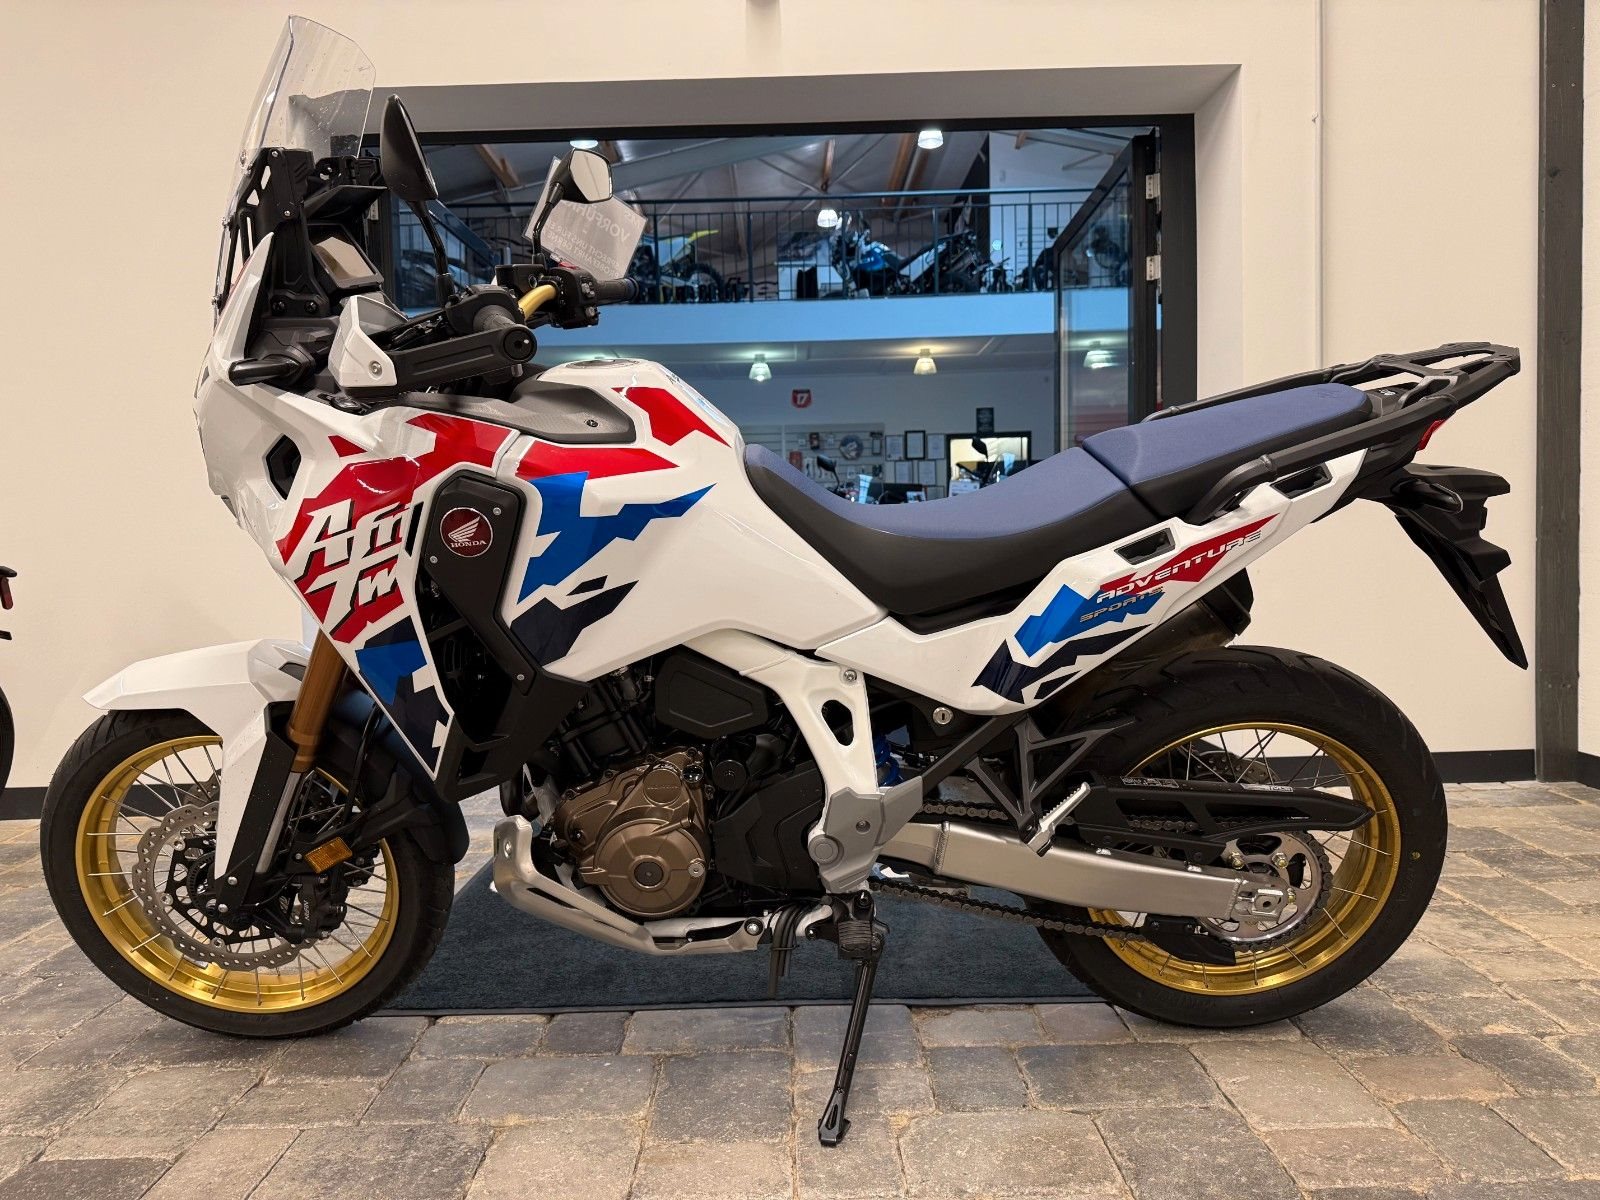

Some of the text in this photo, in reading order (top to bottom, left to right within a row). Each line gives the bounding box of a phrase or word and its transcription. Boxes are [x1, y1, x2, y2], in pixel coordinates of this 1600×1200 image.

[450, 540, 487, 548] HONDA
[1096, 529, 1262, 604] ADVENTURE
[1079, 586, 1164, 623] SPORTS
